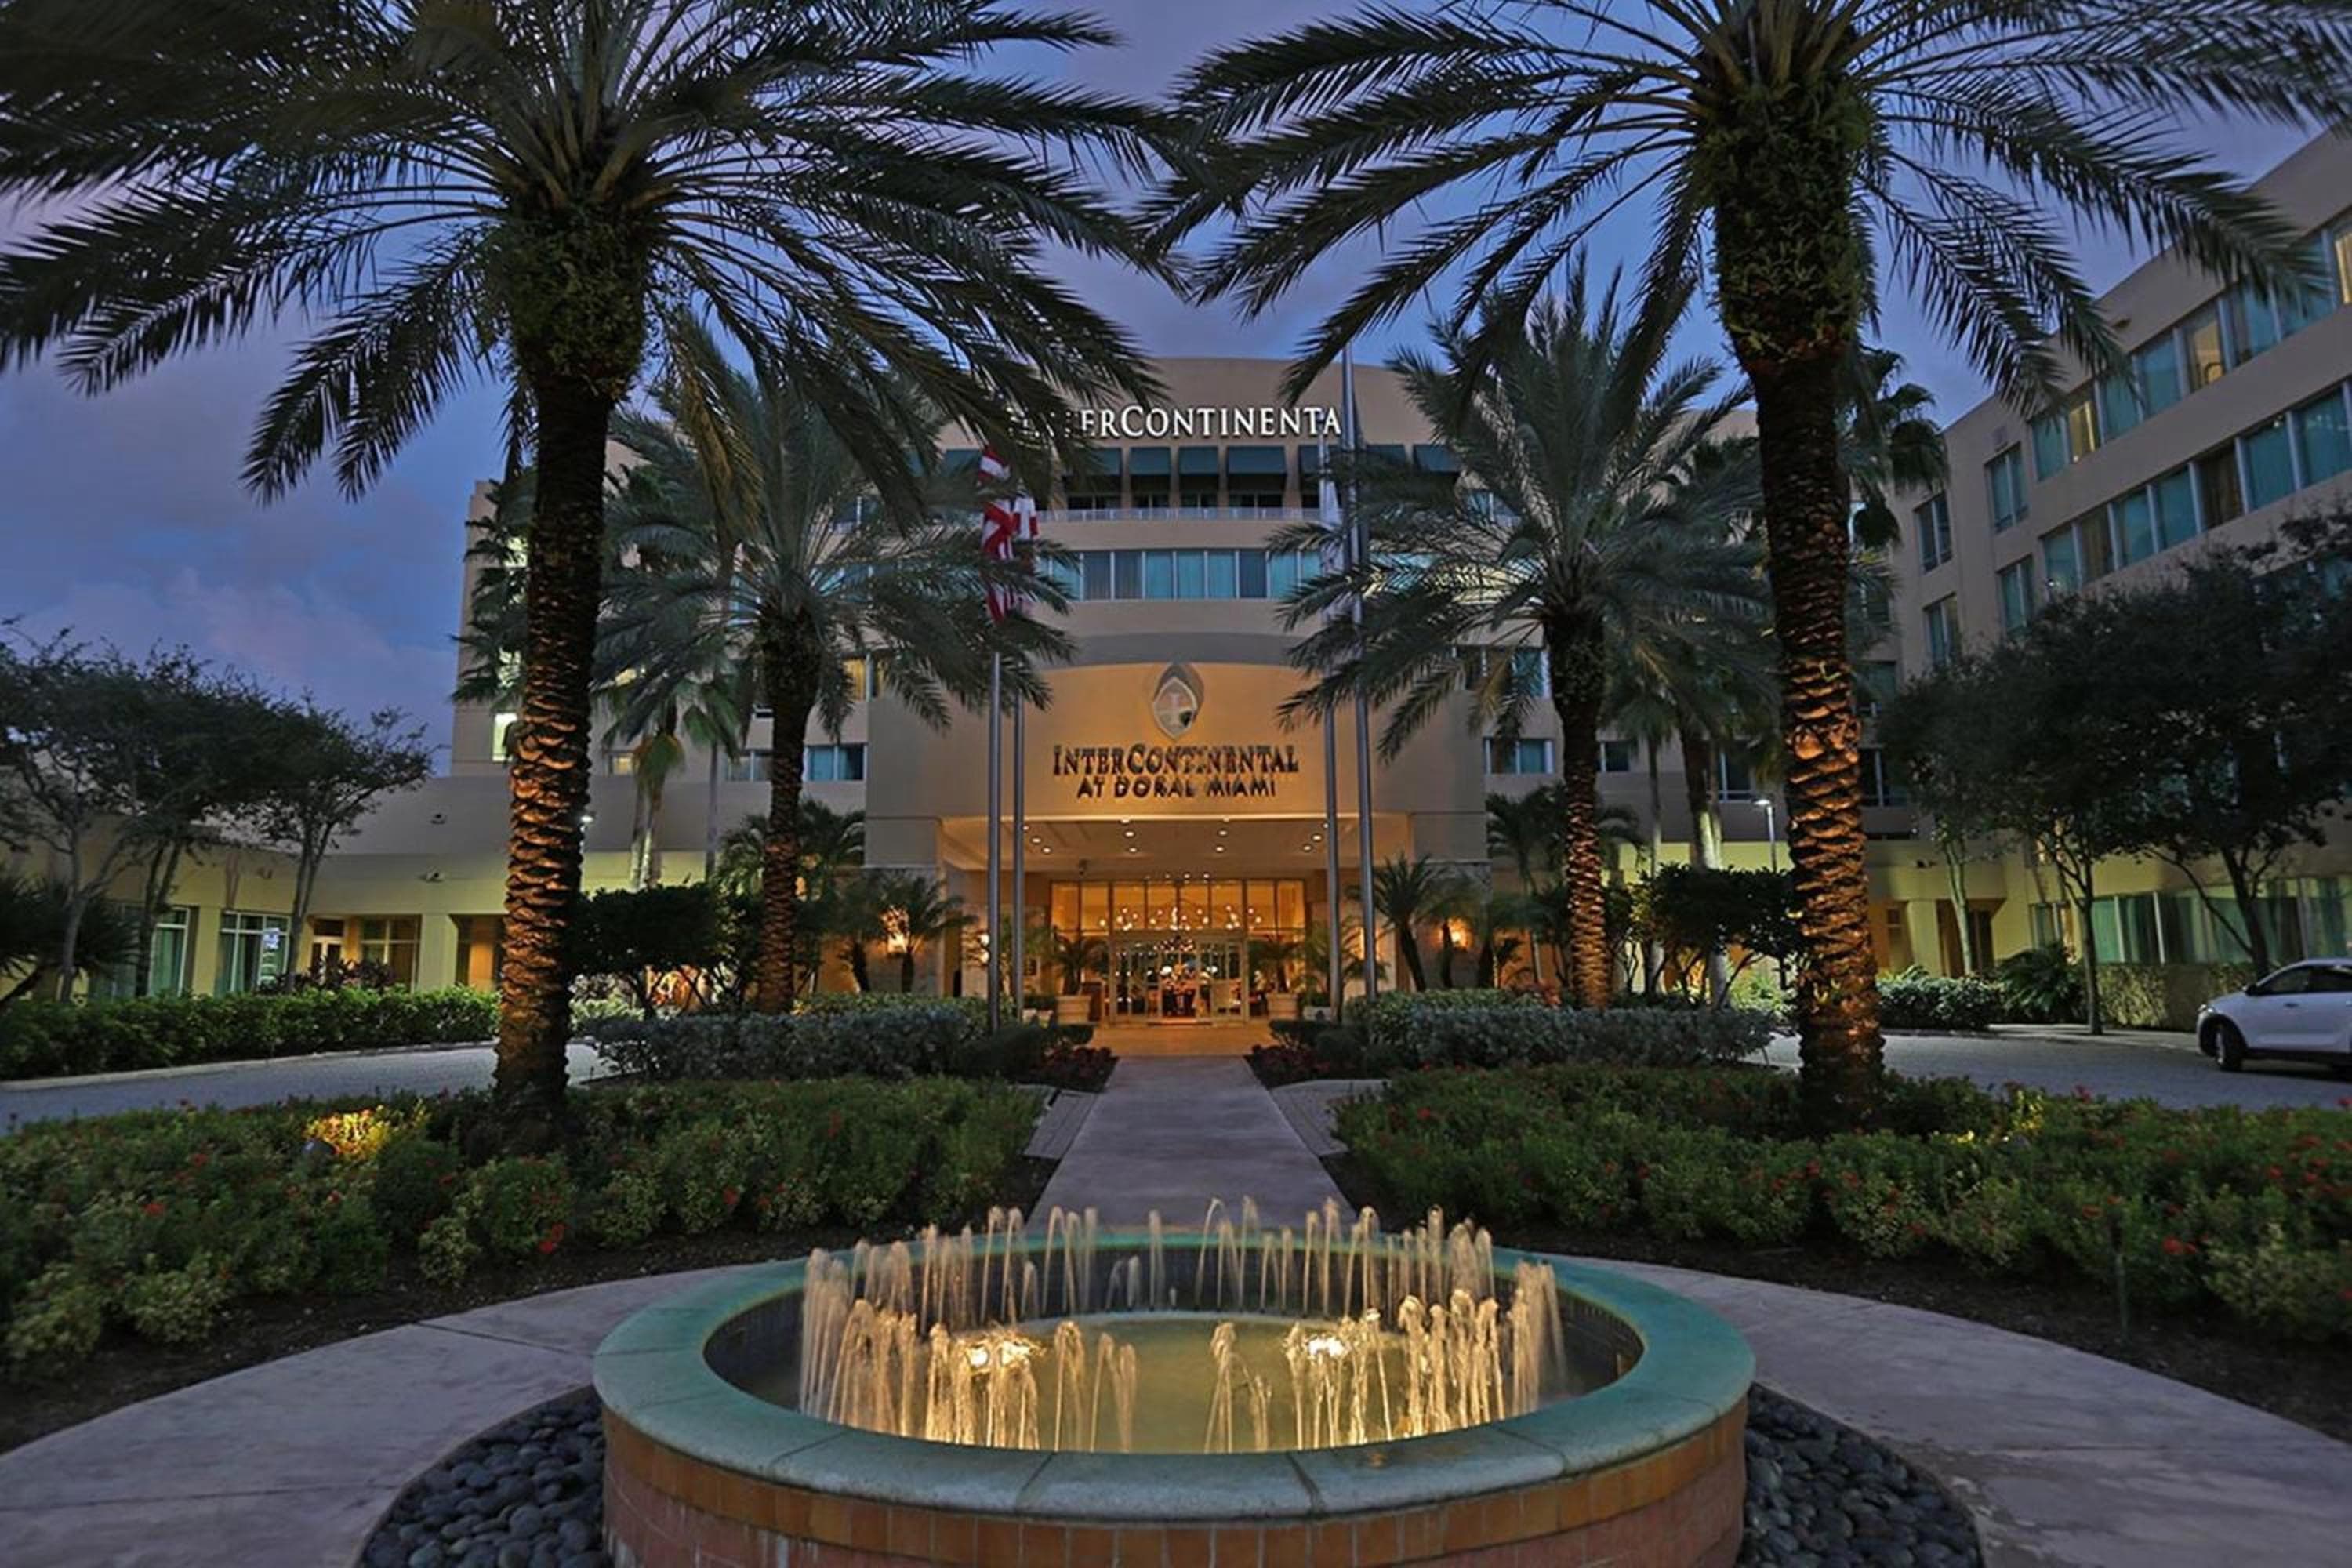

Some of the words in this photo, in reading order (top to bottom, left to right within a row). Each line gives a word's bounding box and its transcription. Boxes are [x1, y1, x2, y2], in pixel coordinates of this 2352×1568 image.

[1006, 403, 1352, 438] ERCONTINENTA
[1076, 778, 1105, 798] AT
[1113, 776, 1195, 798] DORAL
[1206, 775, 1276, 797] MIAMI
